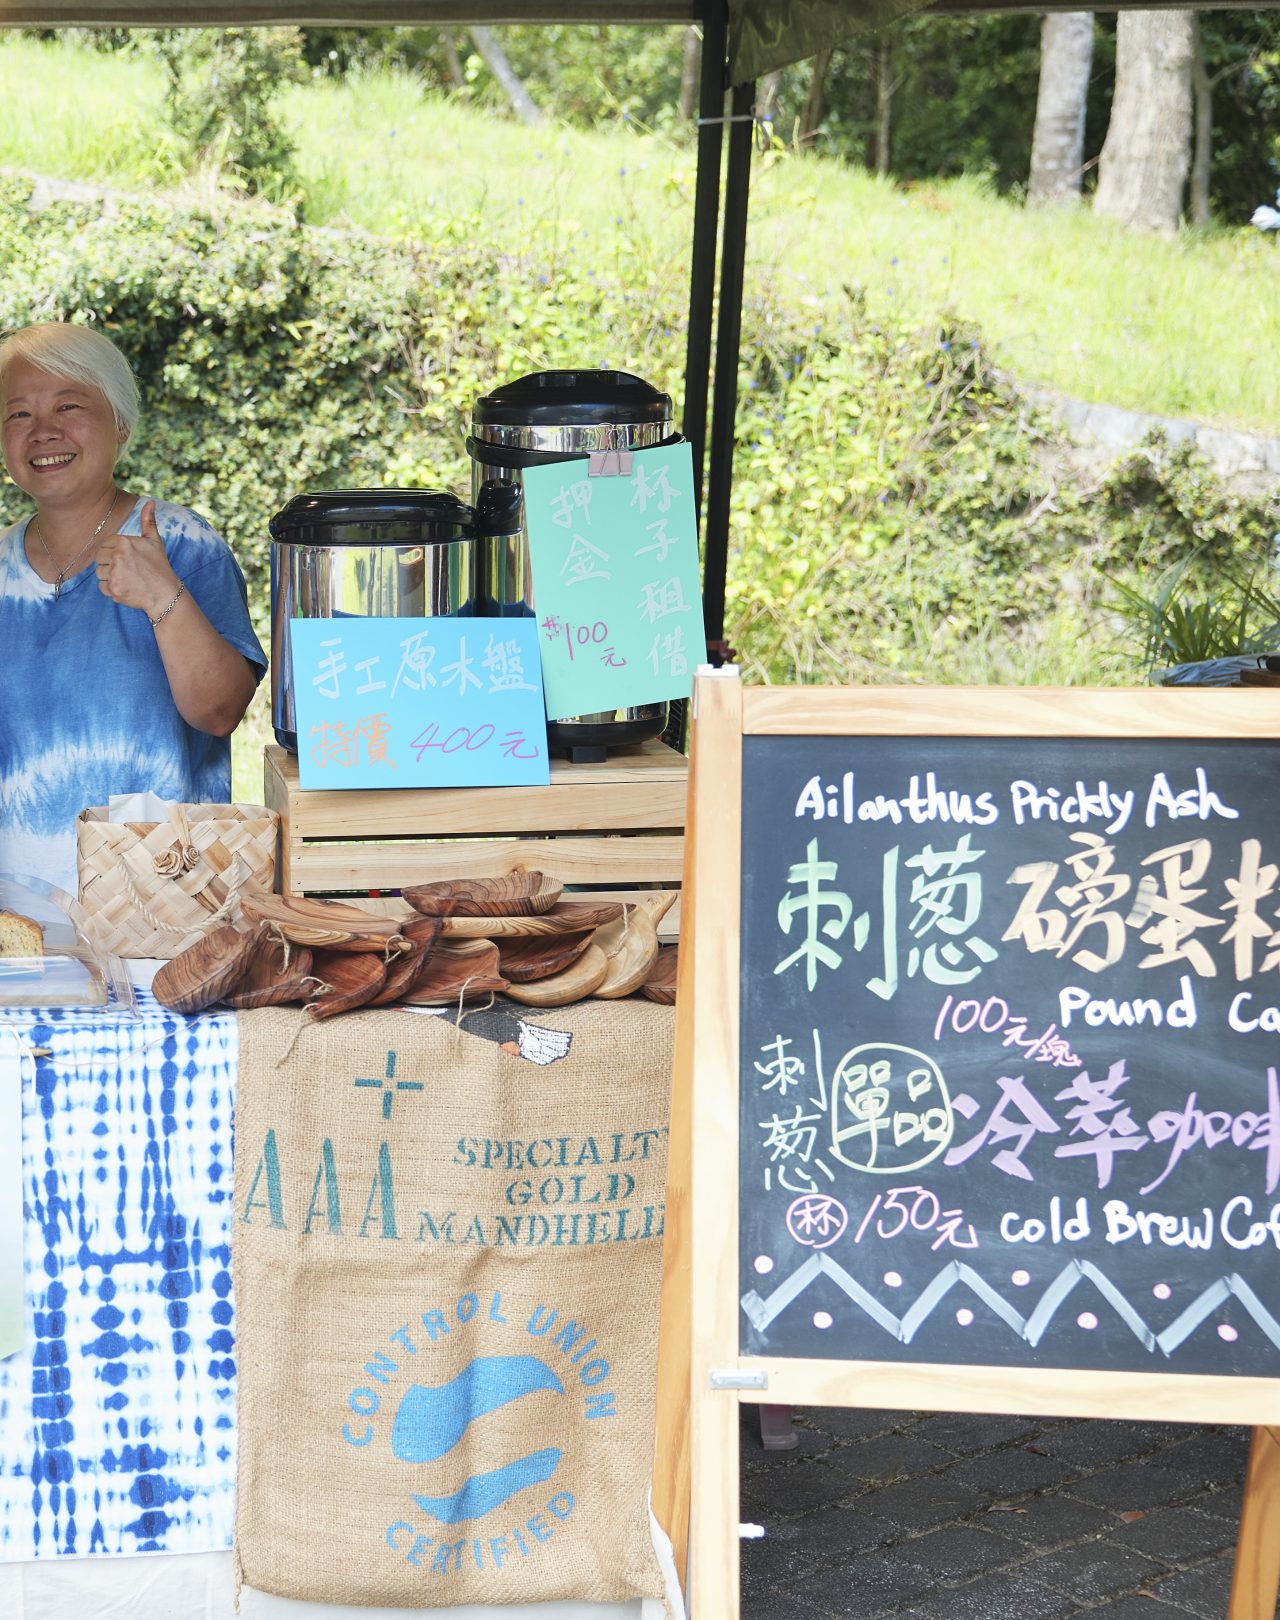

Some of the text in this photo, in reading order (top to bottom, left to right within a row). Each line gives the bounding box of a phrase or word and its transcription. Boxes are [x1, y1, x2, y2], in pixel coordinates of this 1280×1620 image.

[549, 480, 613, 586] 押金
[629, 463, 691, 678] 杯子租借
[311, 630, 539, 699] 手工原木盤
[309, 712, 399, 772] 特價
[795, 768, 1239, 834] Ailanthus Prickly Ash
[1059, 975, 1197, 1028] Pound
[452, 1126, 669, 1169] SPECIALT
[505, 1173, 636, 1207] GOLD
[1000, 1196, 1091, 1243] cold
[1103, 1200, 1214, 1250] Brew
[342, 1290, 617, 1447] CONTROL UNION
[386, 1490, 576, 1576] CERTIFIED
